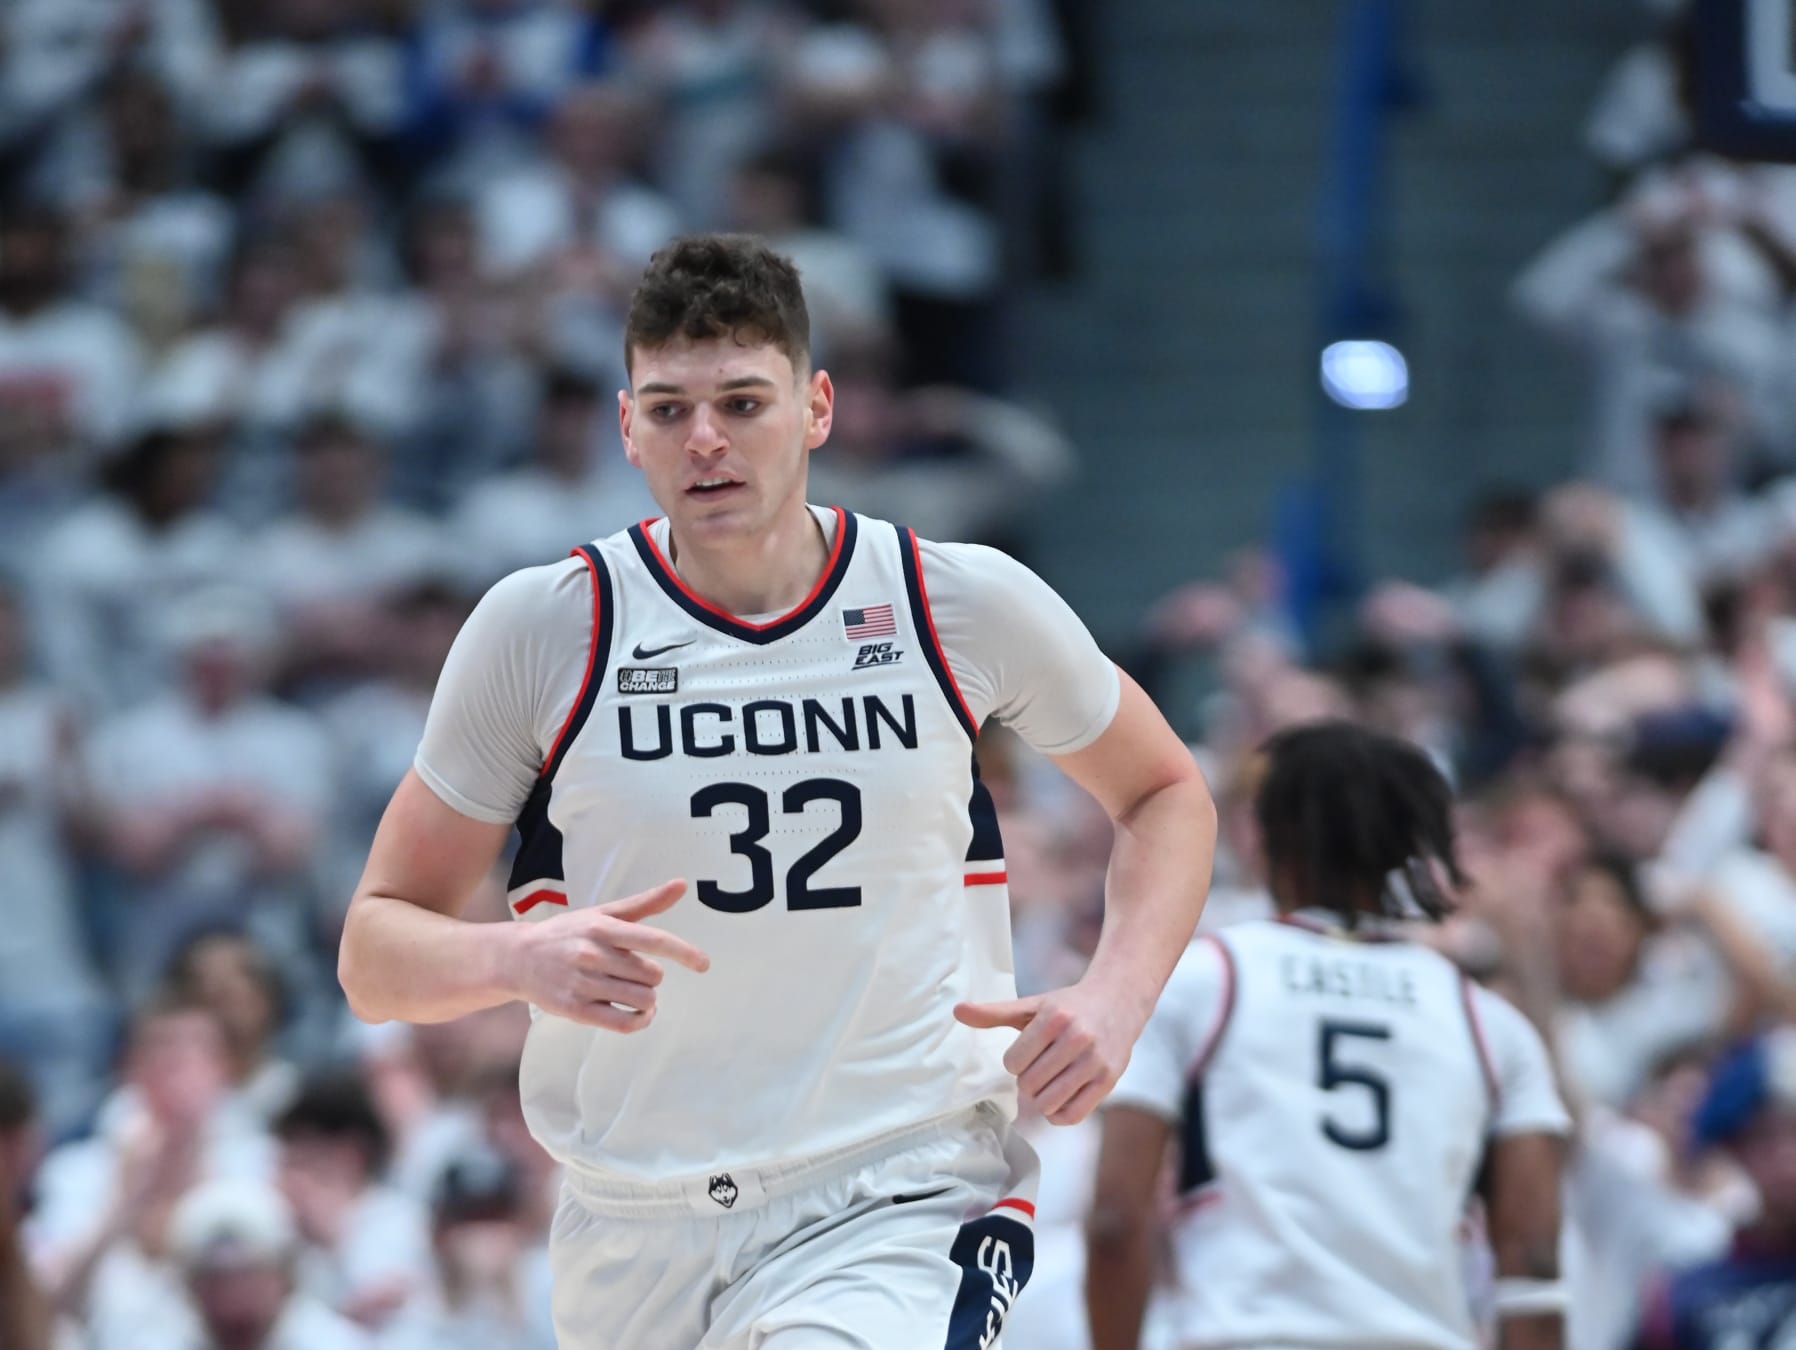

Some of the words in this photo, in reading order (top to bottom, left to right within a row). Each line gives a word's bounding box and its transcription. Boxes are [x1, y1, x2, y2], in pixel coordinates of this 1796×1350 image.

[855, 651, 904, 665] EAST
[858, 642, 893, 656] BIG
[619, 680, 676, 691] CHANGE
[618, 694, 918, 761] UCONN
[690, 778, 862, 913] 32
[1316, 1017, 1392, 1152] 5
